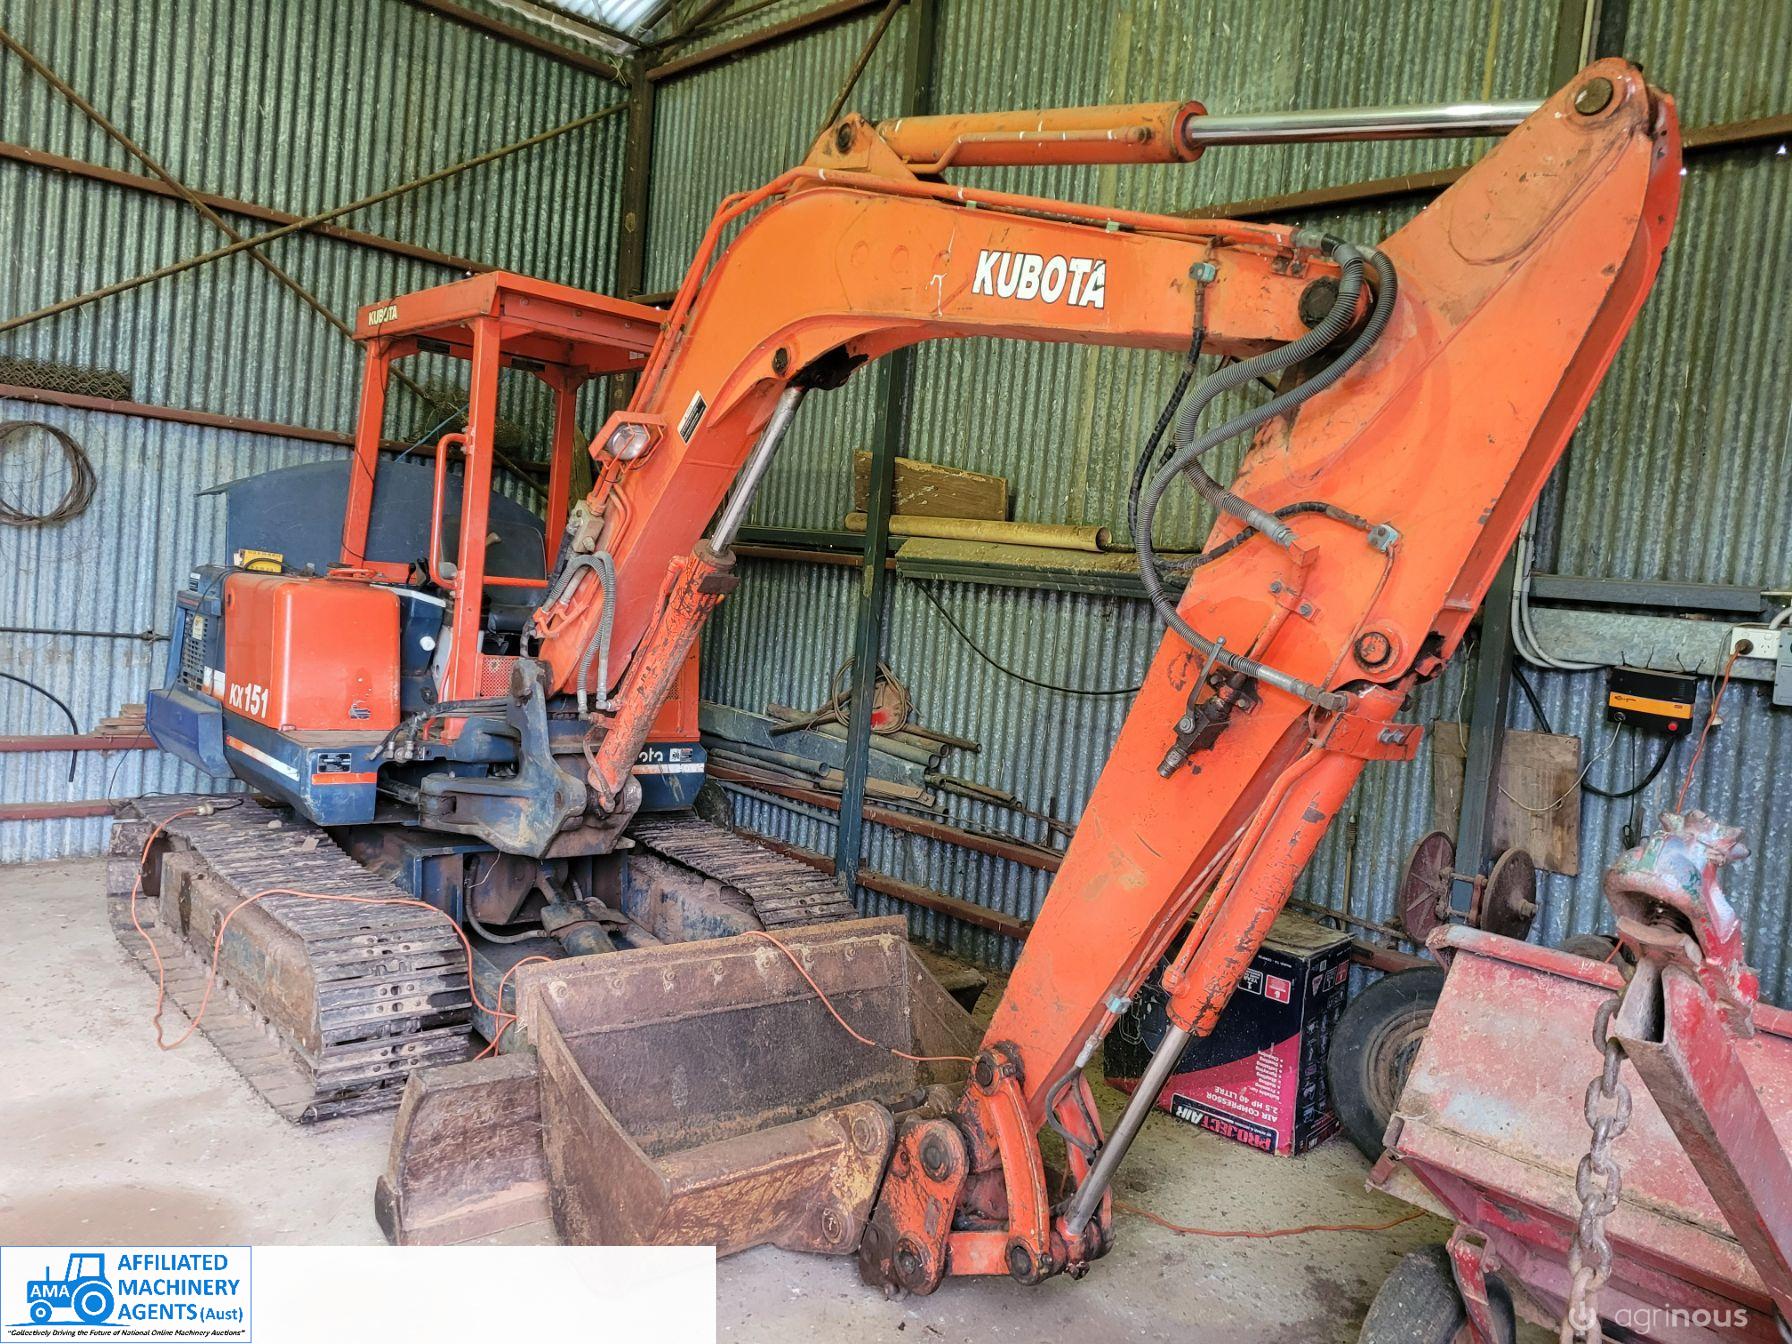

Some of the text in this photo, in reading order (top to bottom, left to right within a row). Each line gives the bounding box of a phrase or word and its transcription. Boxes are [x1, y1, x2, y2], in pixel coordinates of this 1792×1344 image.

[971, 249, 1106, 309] KUBOTA
[368, 305, 398, 325] KUBOTA
[229, 683, 269, 718] KX151
[1206, 1091, 1278, 1122] AIR COMPRESSOR
[1214, 1086, 1278, 1114] 2.5 HP 40 LITRE
